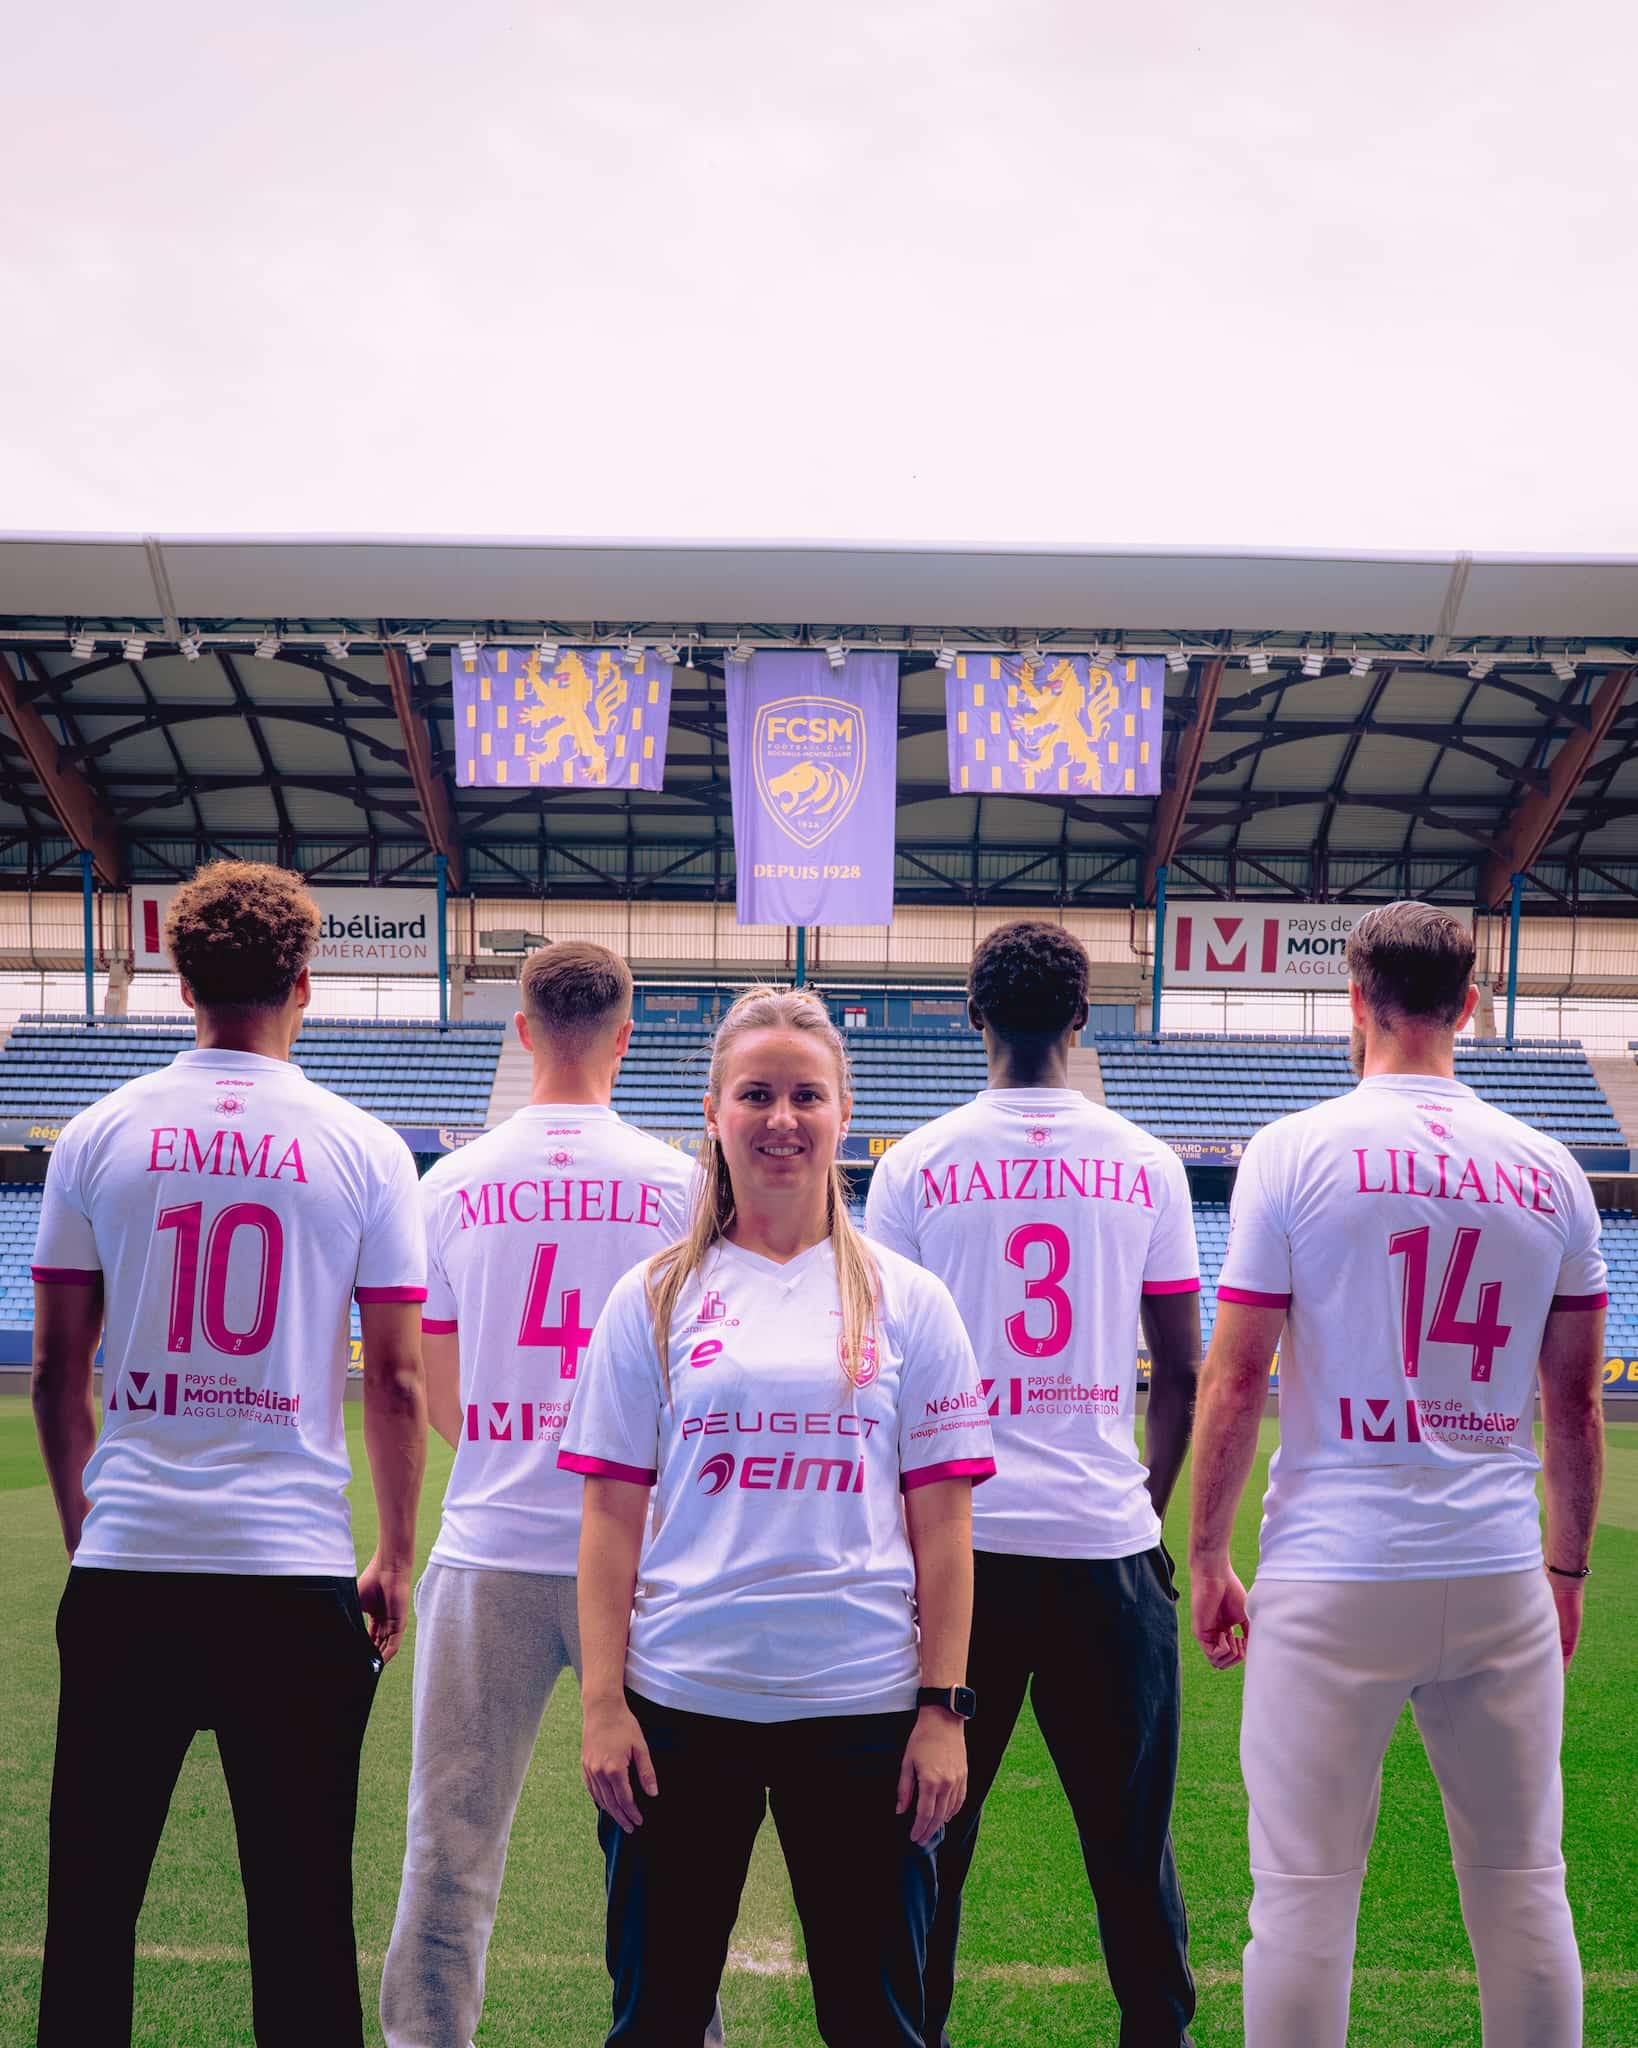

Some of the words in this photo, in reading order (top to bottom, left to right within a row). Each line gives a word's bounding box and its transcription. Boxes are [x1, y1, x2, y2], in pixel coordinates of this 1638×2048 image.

[767, 717, 853, 743] FCSM
[753, 864, 819, 880] DEPUIS
[823, 863, 861, 880] 1928
[1287, 918, 1327, 935] Pays
[1330, 915, 1352, 932] de
[146, 1127, 309, 1184] EMMA
[457, 1180, 663, 1229] MICHELE
[920, 1157, 1154, 1209] MAIZINHA
[1353, 1148, 1556, 1214] LILIANE
[157, 1201, 284, 1356] 10
[1005, 1223, 1072, 1358] 3
[517, 1243, 593, 1379] 4
[1388, 1225, 1513, 1382] 14
[185, 1373, 215, 1388] Pays
[219, 1372, 237, 1386] de
[926, 1391, 977, 1417] Néolia
[1028, 1375, 1055, 1387] Pays
[1057, 1373, 1073, 1385] de
[1444, 1399, 1463, 1412] de
